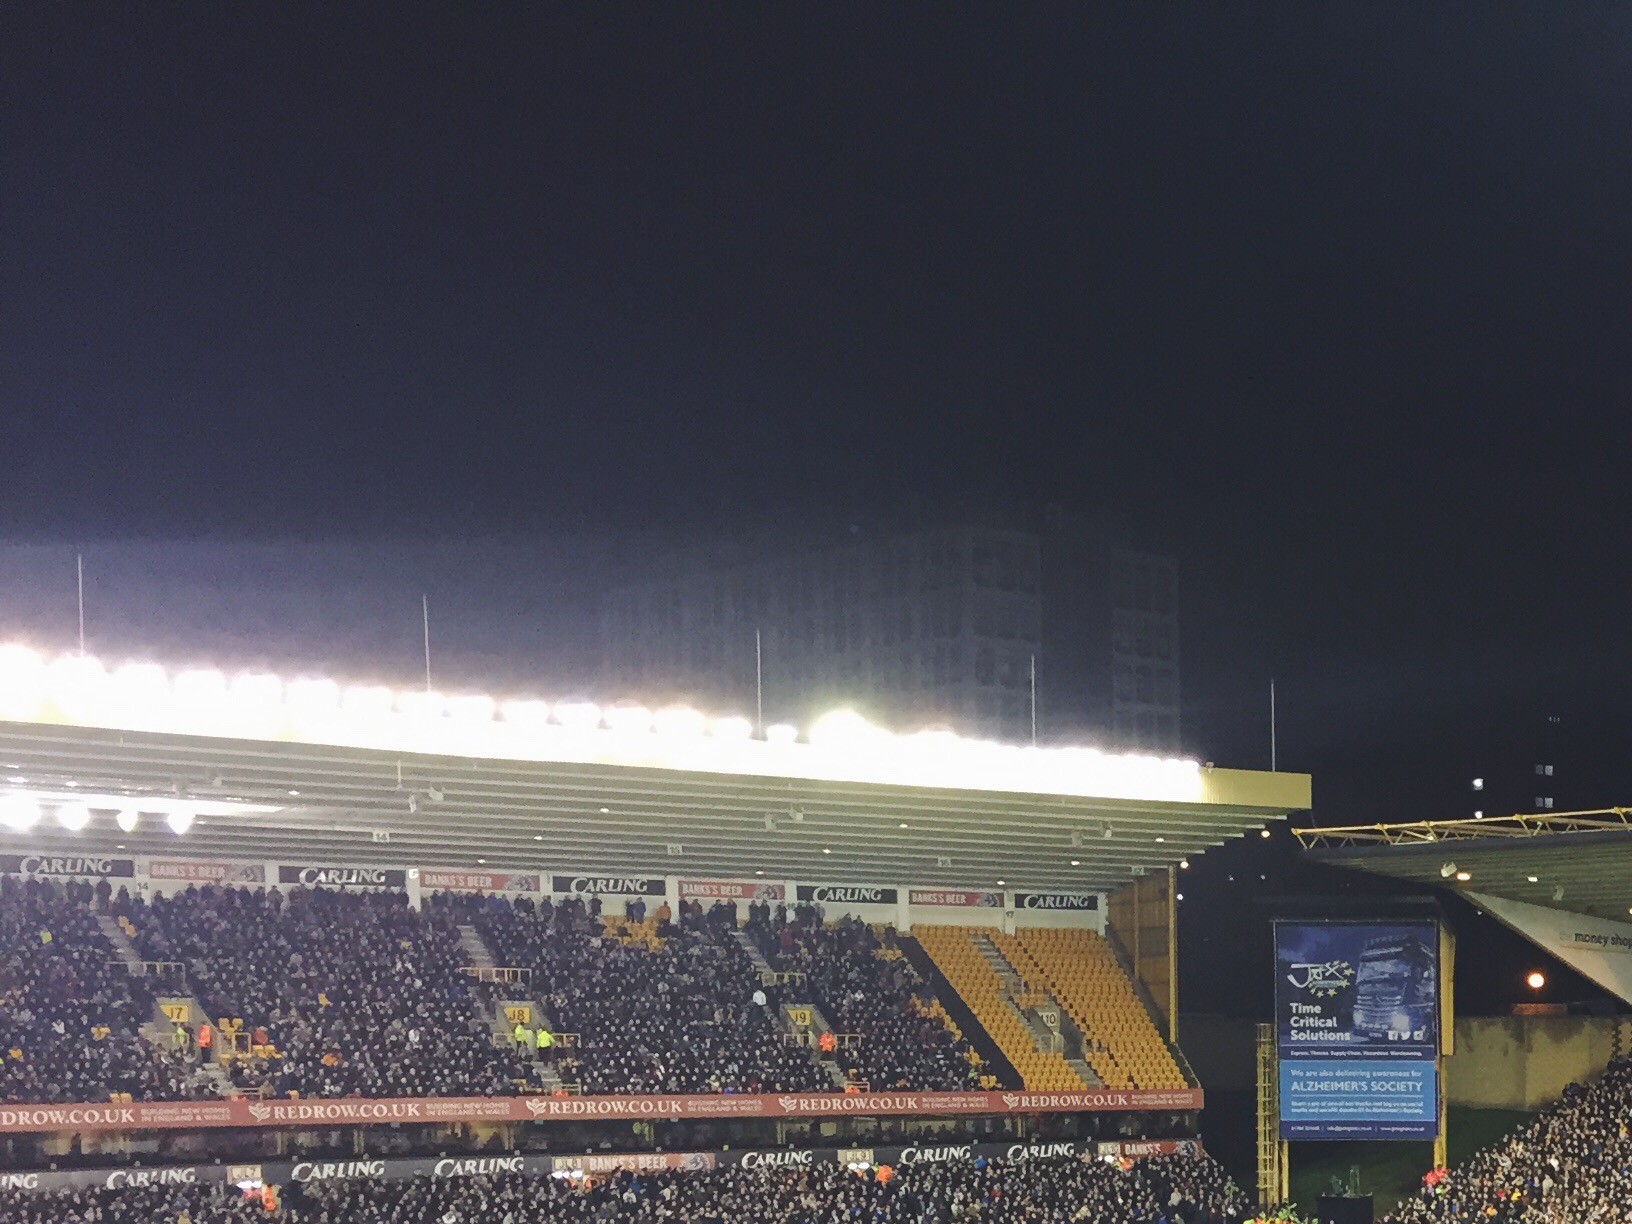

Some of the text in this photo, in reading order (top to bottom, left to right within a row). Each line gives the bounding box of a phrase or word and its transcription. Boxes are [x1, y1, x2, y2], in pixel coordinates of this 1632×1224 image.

[20, 857, 112, 876] CARLING
[299, 867, 386, 886] CARLING
[570, 877, 648, 895] CARLING
[812, 886, 882, 902] CARLING
[1024, 895, 1089, 909] CARLING
[1574, 932, 1609, 947] money
[1290, 1003, 1321, 1013] Time
[1290, 1016, 1337, 1028] Critical
[1291, 1030, 1350, 1041] Solutions
[1291, 1081, 1423, 1092] ALZHEIMER'S SOCIETY
[550, 1099, 682, 1114] REDROW.CO.UK
[800, 1096, 918, 1111] REDROW.CO.UK
[1021, 1094, 1128, 1108] REDROW.CO.UK
[274, 1102, 420, 1120] REDROW.CO.UK
[741, 1150, 812, 1169] CARLING
[900, 1146, 971, 1165] CARLING
[1007, 1143, 1075, 1164] CARLING
[434, 1157, 524, 1178] CARLING
[638, 1156, 667, 1169] BEER
[291, 1161, 385, 1182] CARLING
